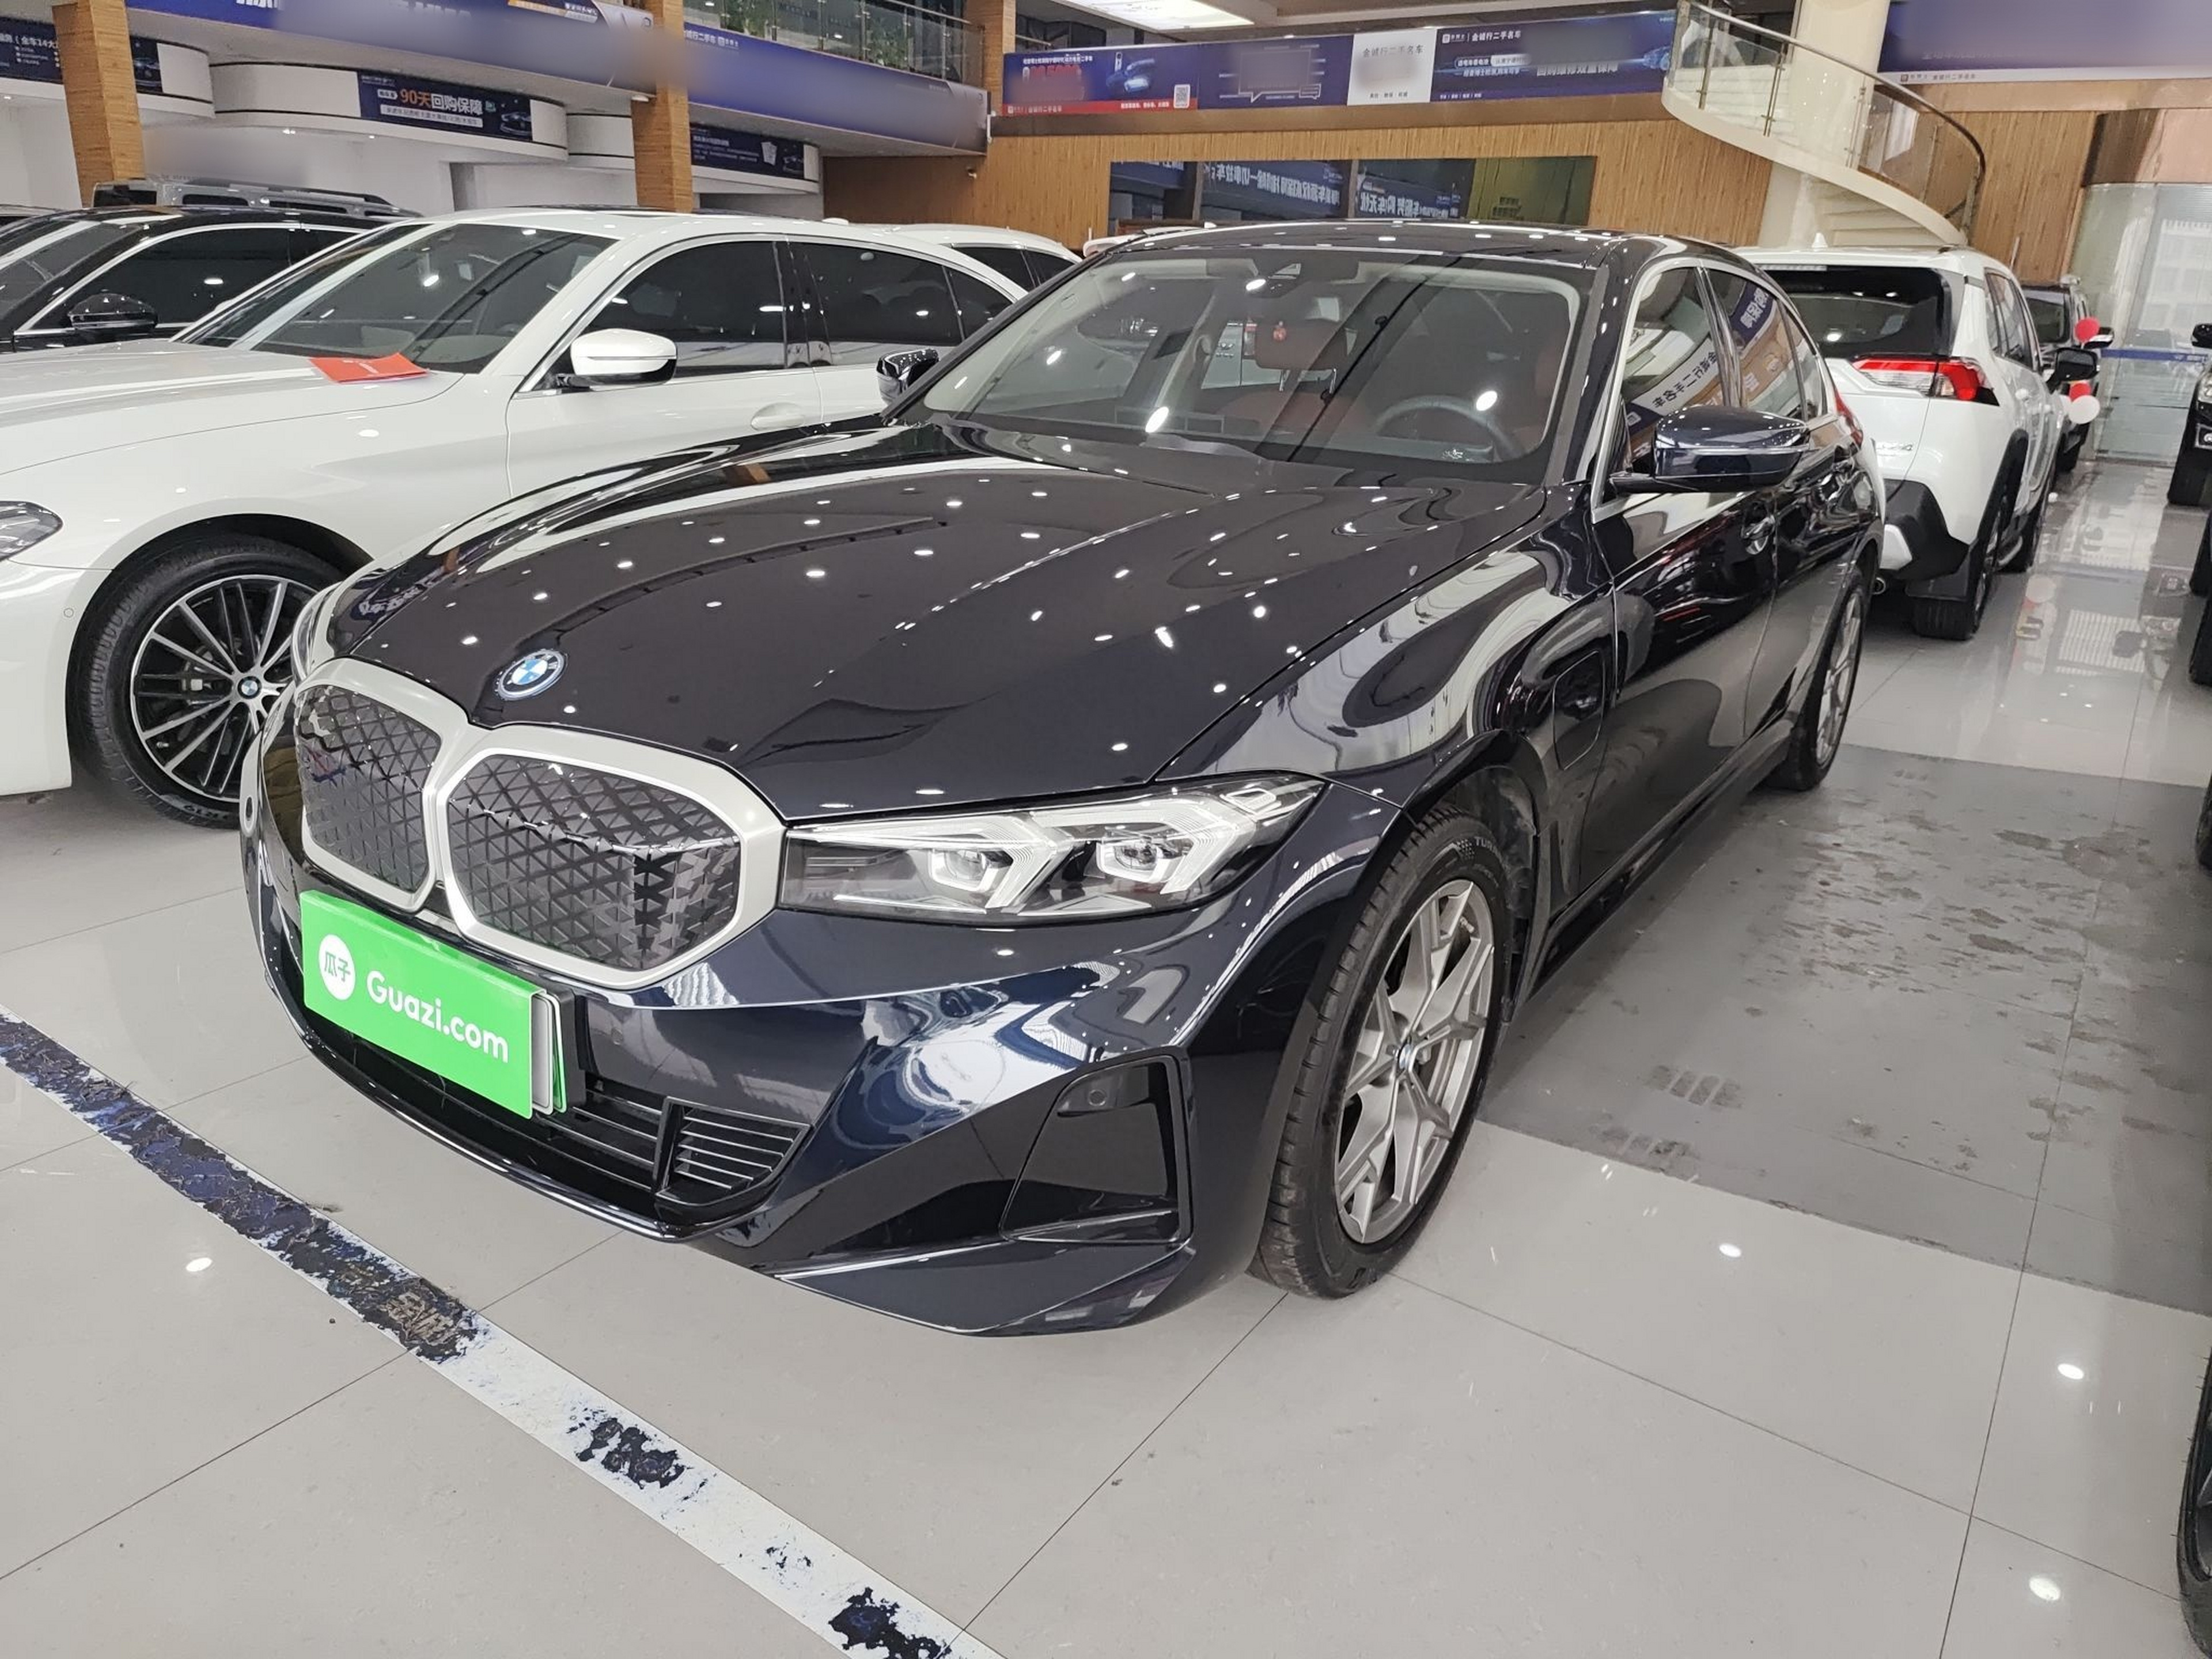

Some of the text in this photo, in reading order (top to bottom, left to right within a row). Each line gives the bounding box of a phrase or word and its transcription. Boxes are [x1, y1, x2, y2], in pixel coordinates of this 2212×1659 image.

[1472, 30, 1521, 41] 金诚行二手名车
[399, 88, 483, 116] 90天回购保障
[324, 951, 351, 983] 瓜子
[366, 970, 509, 1063] Guazi.com
